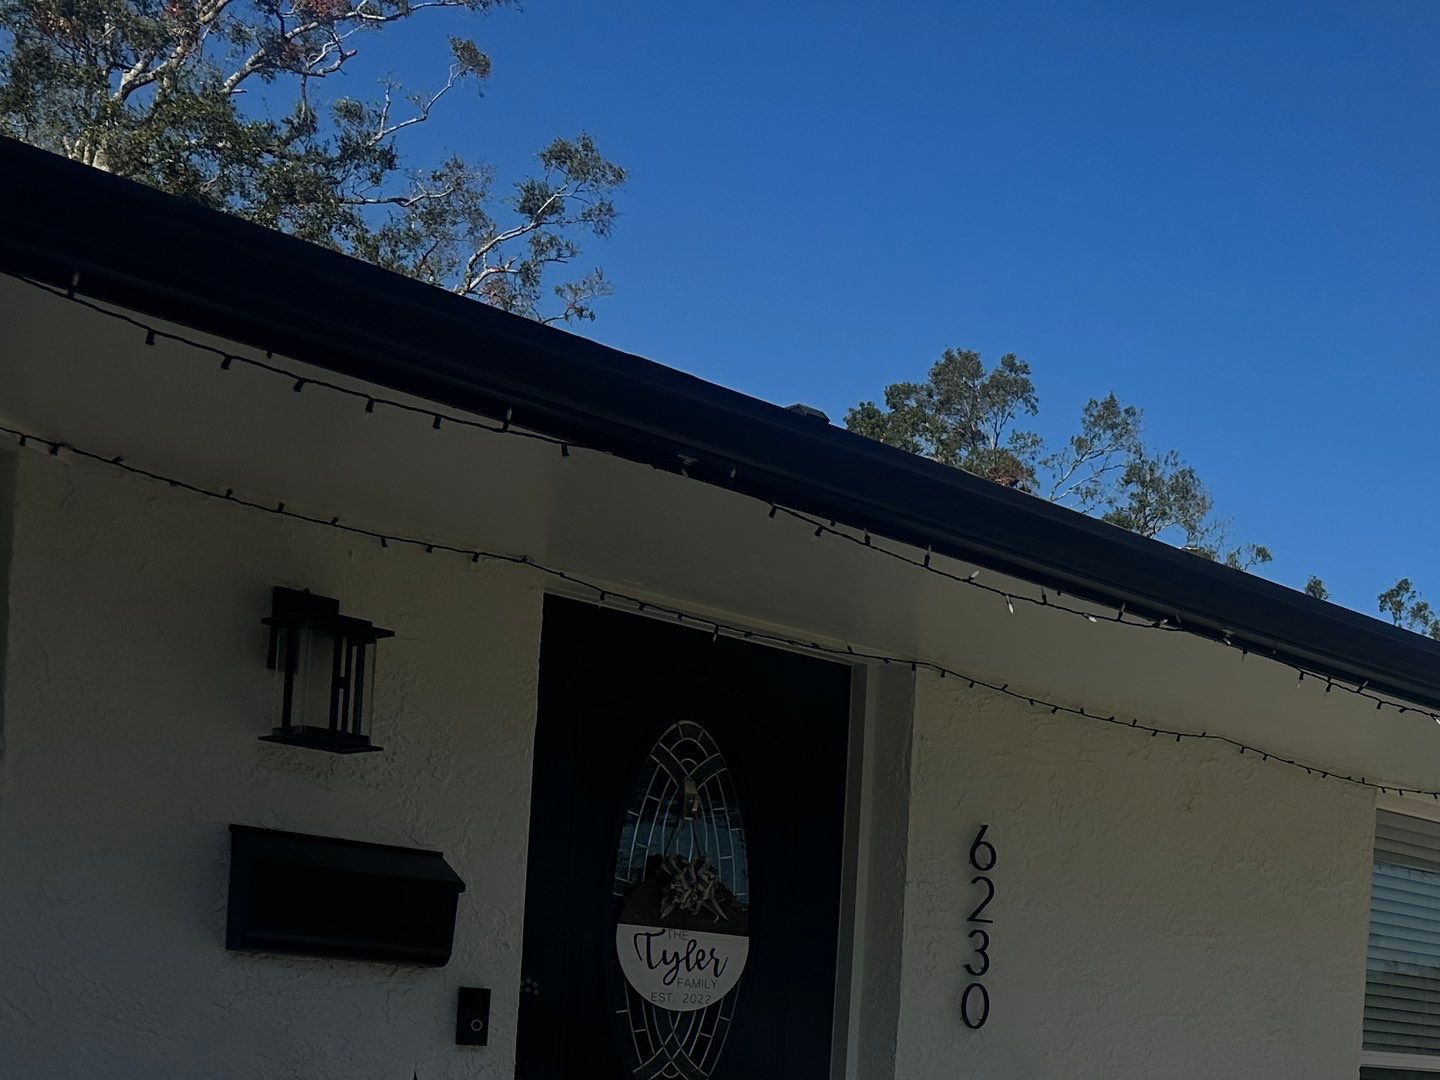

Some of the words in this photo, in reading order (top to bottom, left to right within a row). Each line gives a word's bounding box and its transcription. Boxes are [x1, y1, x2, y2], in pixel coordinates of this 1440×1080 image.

[961, 824, 997, 1030] 6230
[666, 929, 689, 941] THE
[633, 929, 729, 986] Tyler
[676, 978, 719, 989] FAMILY
[682, 993, 713, 1005] 2022
